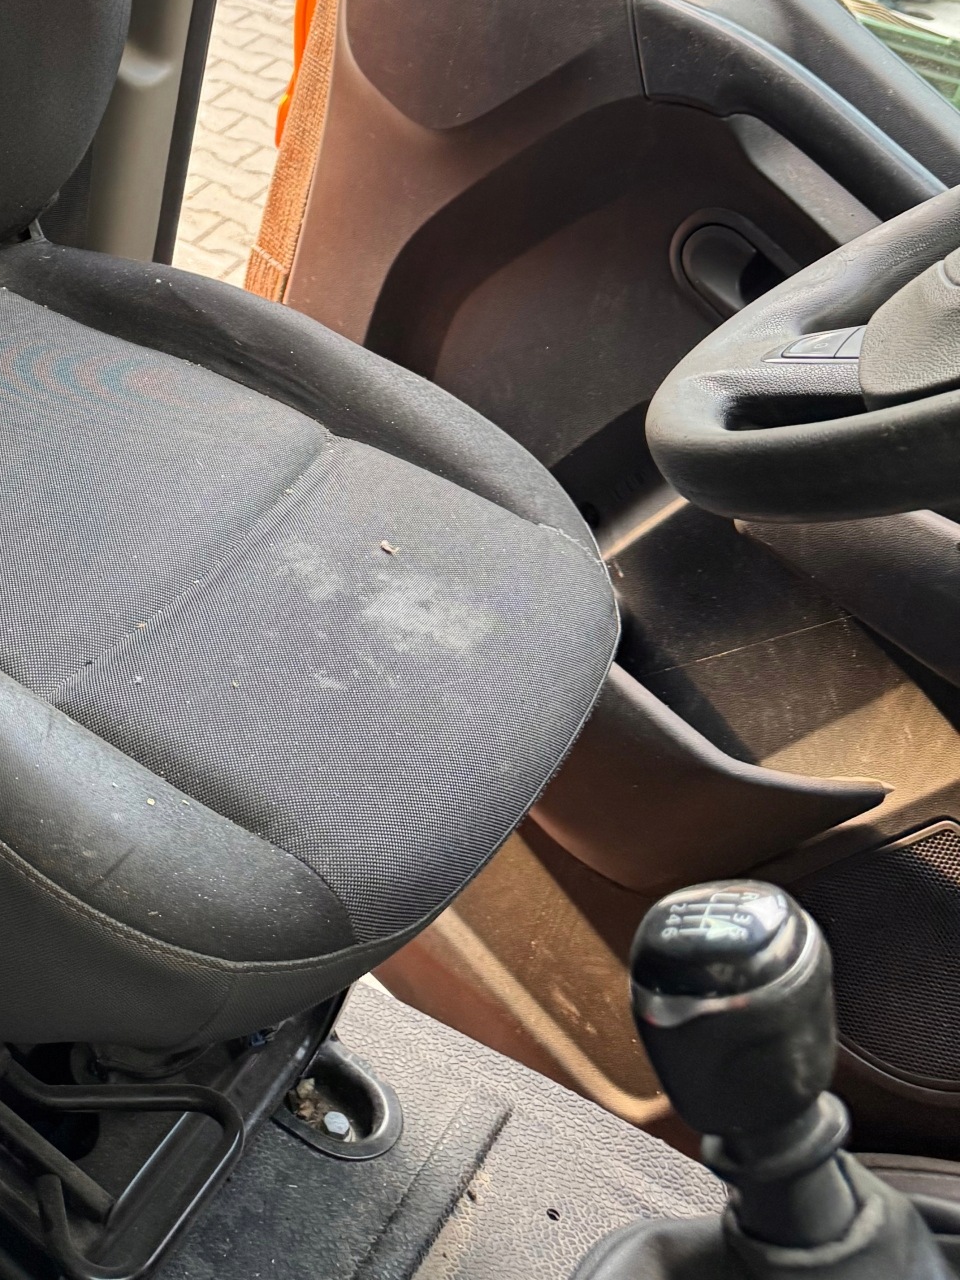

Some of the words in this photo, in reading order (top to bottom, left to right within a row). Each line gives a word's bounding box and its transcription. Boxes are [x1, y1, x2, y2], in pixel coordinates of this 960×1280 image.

[741, 892, 760, 901] R
[670, 903, 688, 913] 2
[665, 913, 682, 925] 4
[733, 913, 751, 924] 3
[661, 927, 679, 939] 6
[728, 927, 748, 939] 5
